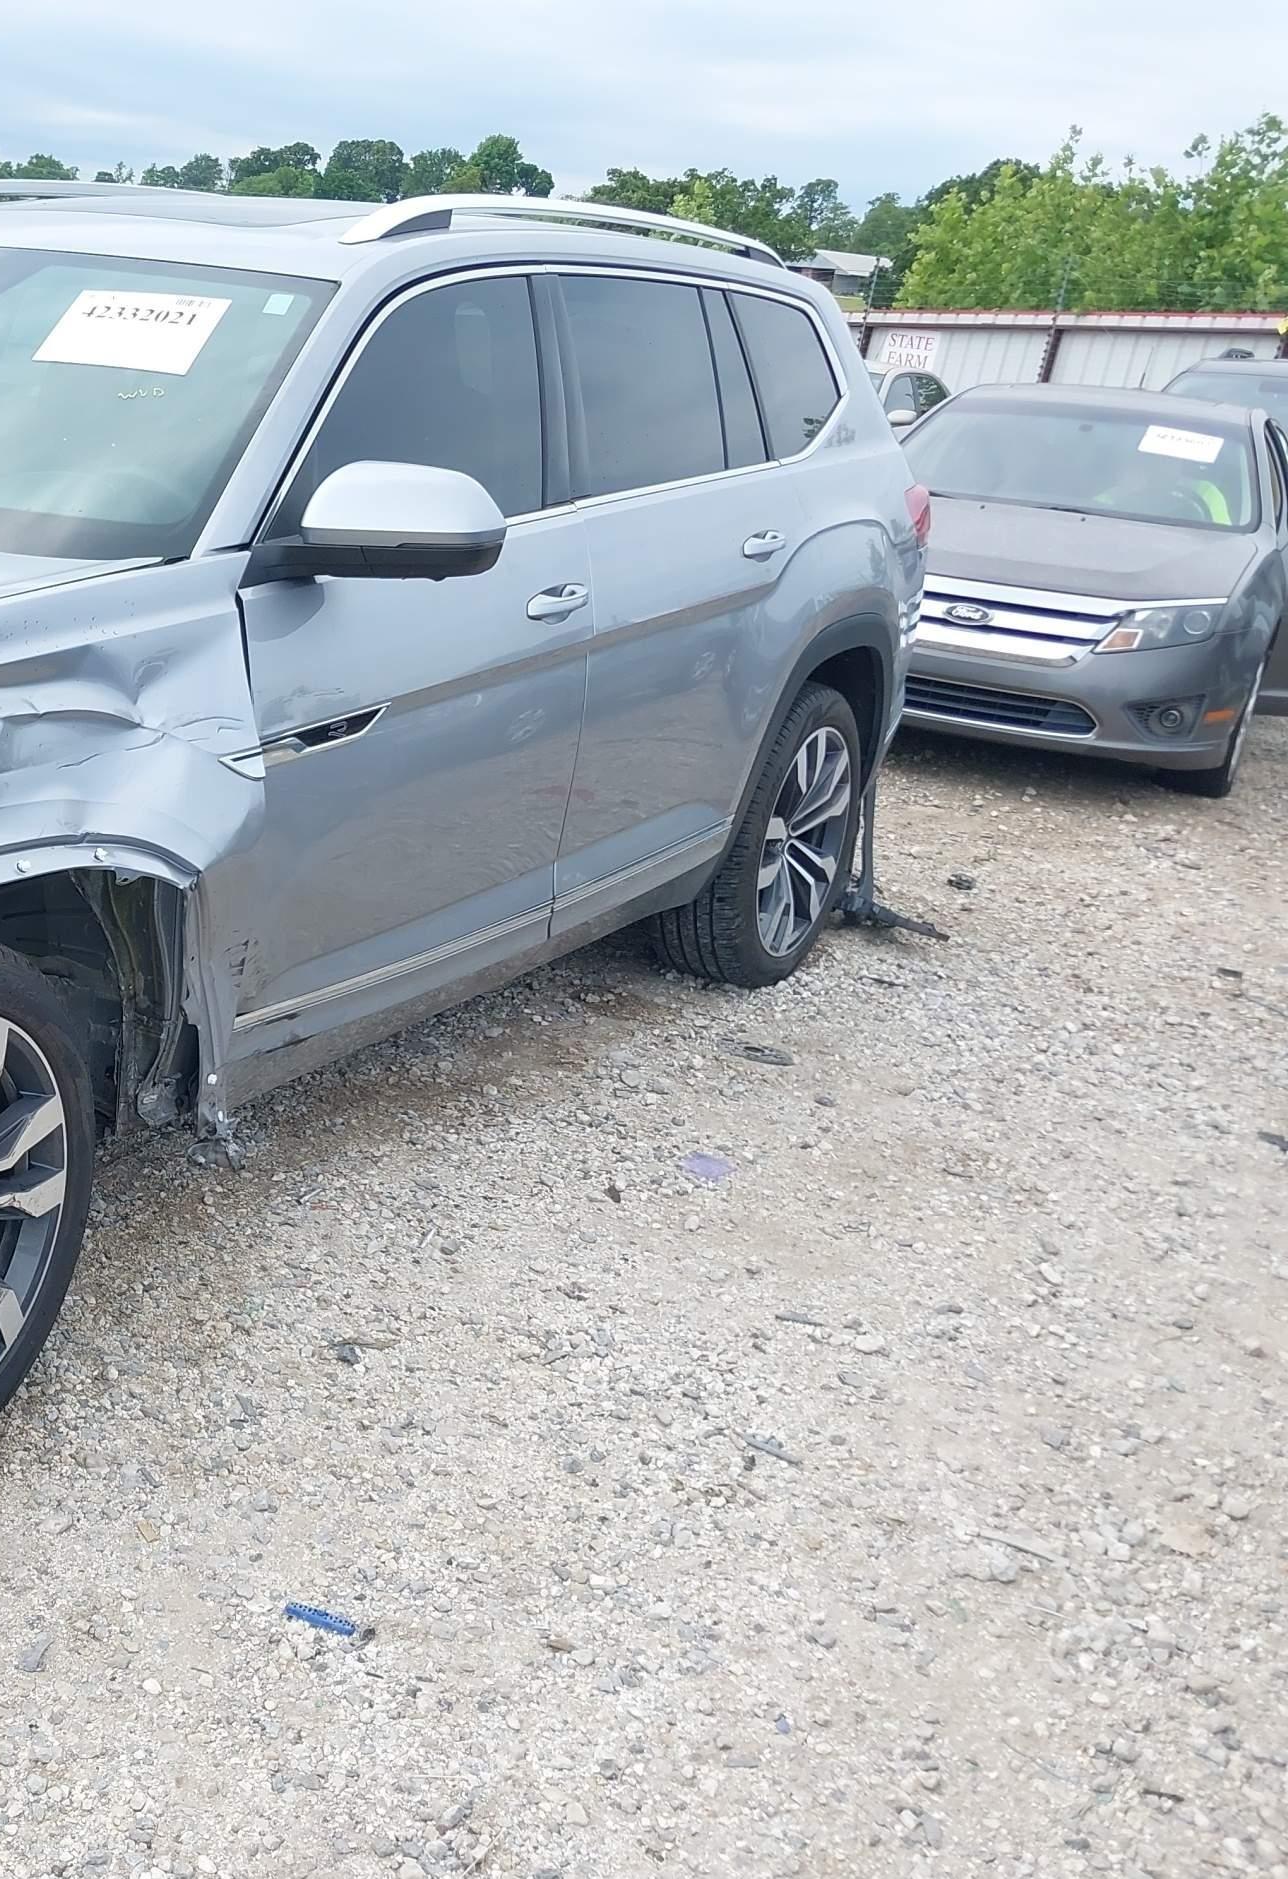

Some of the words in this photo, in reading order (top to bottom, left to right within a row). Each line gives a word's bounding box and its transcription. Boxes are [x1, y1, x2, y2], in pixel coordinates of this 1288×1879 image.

[81, 305, 197, 325] 42332021
[888, 333, 936, 351] STATE
[887, 351, 929, 369] FARM
[951, 605, 983, 620] Ford
